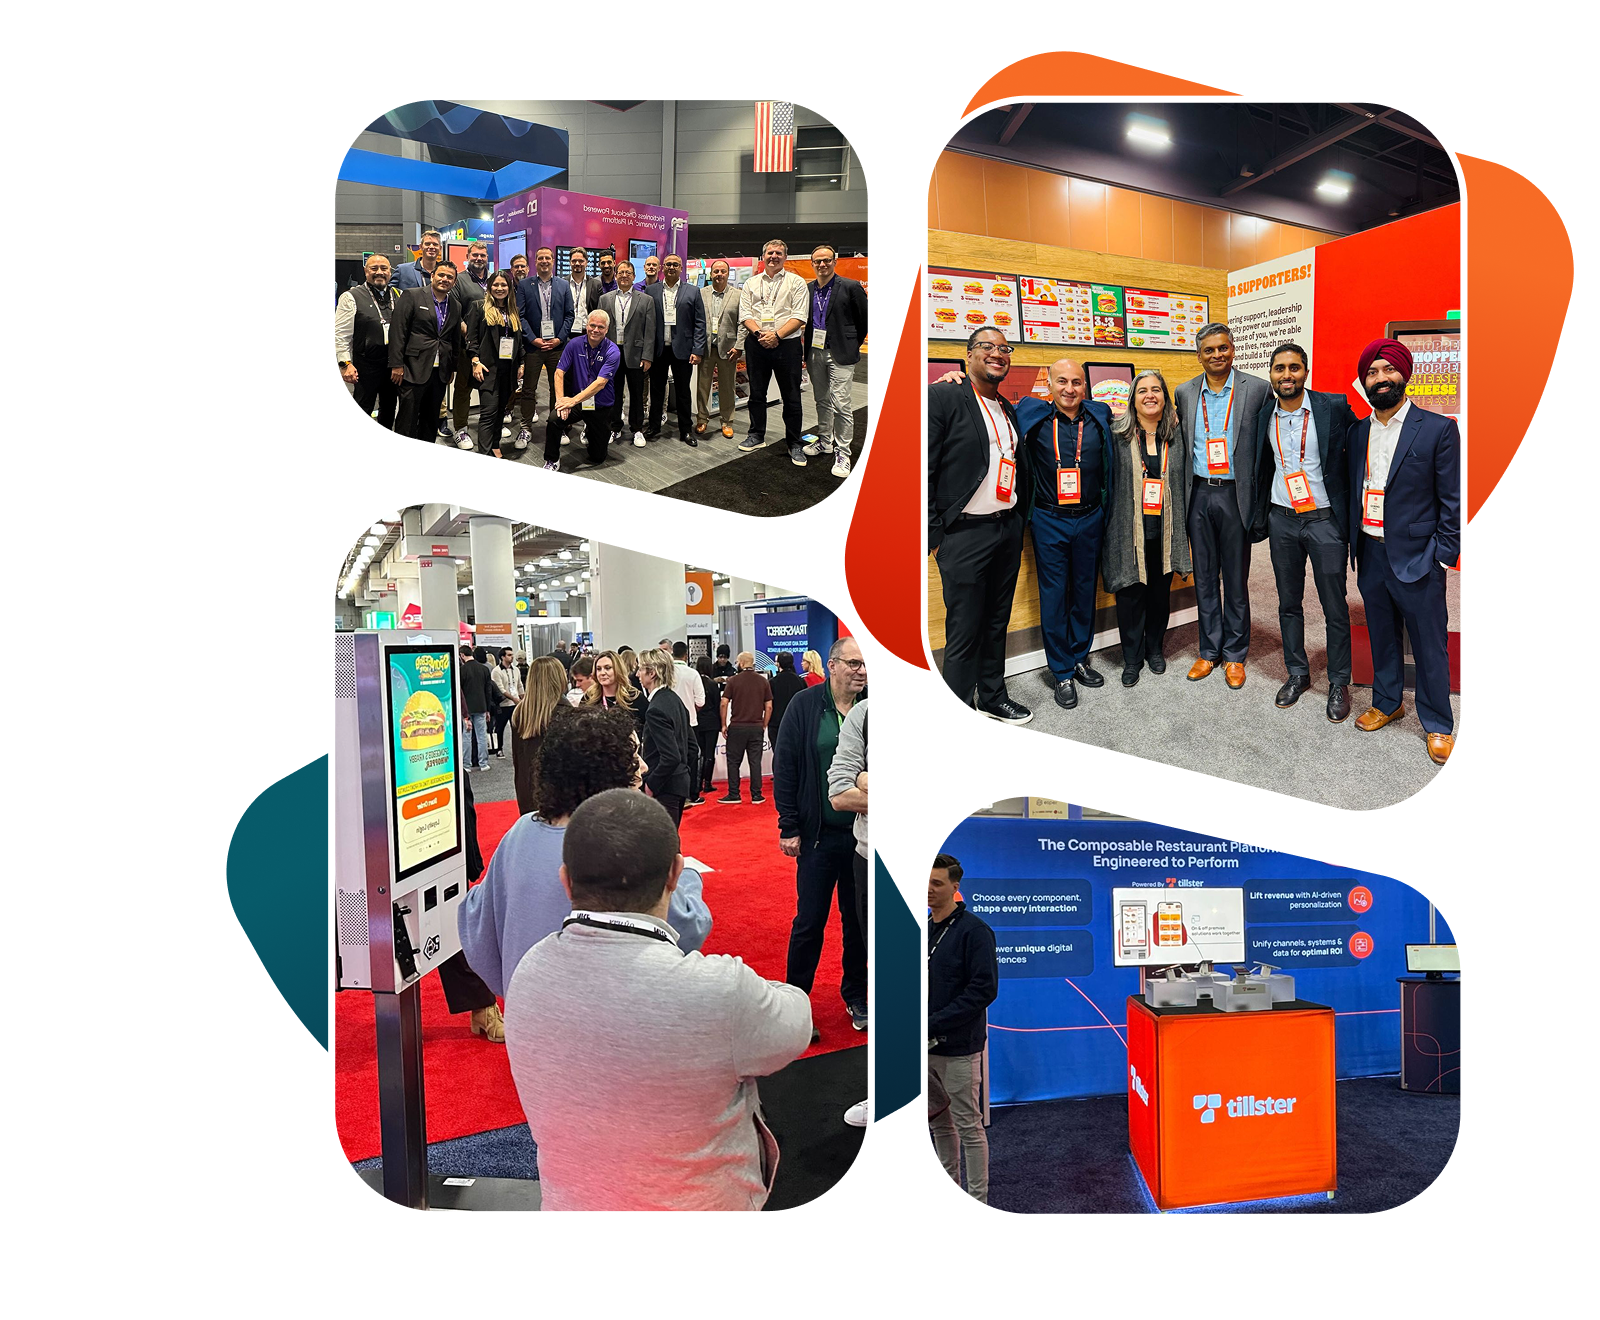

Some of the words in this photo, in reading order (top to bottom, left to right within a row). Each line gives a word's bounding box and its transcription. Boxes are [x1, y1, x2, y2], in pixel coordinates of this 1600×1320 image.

[1238, 264, 1312, 296] SUPPORTERS!
[1244, 311, 1268, 322] support,
[1269, 303, 1302, 317] leadership
[1243, 323, 1260, 333] power
[1272, 316, 1296, 327] mission
[1249, 331, 1255, 340] of
[1255, 332, 1268, 341] you,
[1269, 328, 1286, 337] we're
[1287, 325, 1302, 334] able
[1245, 343, 1259, 351] lives,
[1260, 339, 1276, 348] reach
[1245, 352, 1258, 360] build
[1411, 351, 1461, 362] HOPPE
[1239, 362, 1249, 370] and
[1412, 363, 1461, 374] HOPPE
[1405, 384, 1457, 396] CHEESE
[1038, 839, 1066, 851] The
[1068, 839, 1153, 854] Composable
[1156, 840, 1228, 852] Restaurant
[1093, 855, 1168, 870] Engineered
[1171, 856, 1185, 868] to
[1188, 856, 1239, 868] Perform
[1178, 879, 1204, 887] tillster
[972, 893, 1006, 902] Choose
[1007, 894, 1031, 904] every
[1032, 893, 1082, 904] component,
[972, 904, 1001, 914] shape
[1002, 906, 1027, 914] every
[1029, 904, 1077, 912] interaction
[1290, 901, 1342, 910] personalization
[1015, 944, 1046, 954] unique
[1047, 944, 1072, 954] digital
[1253, 940, 1272, 949] Unify
[1273, 939, 1306, 947] channels,
[1308, 939, 1336, 947] systems
[1301, 948, 1329, 957] optimal
[1226, 1095, 1296, 1118] tillster
